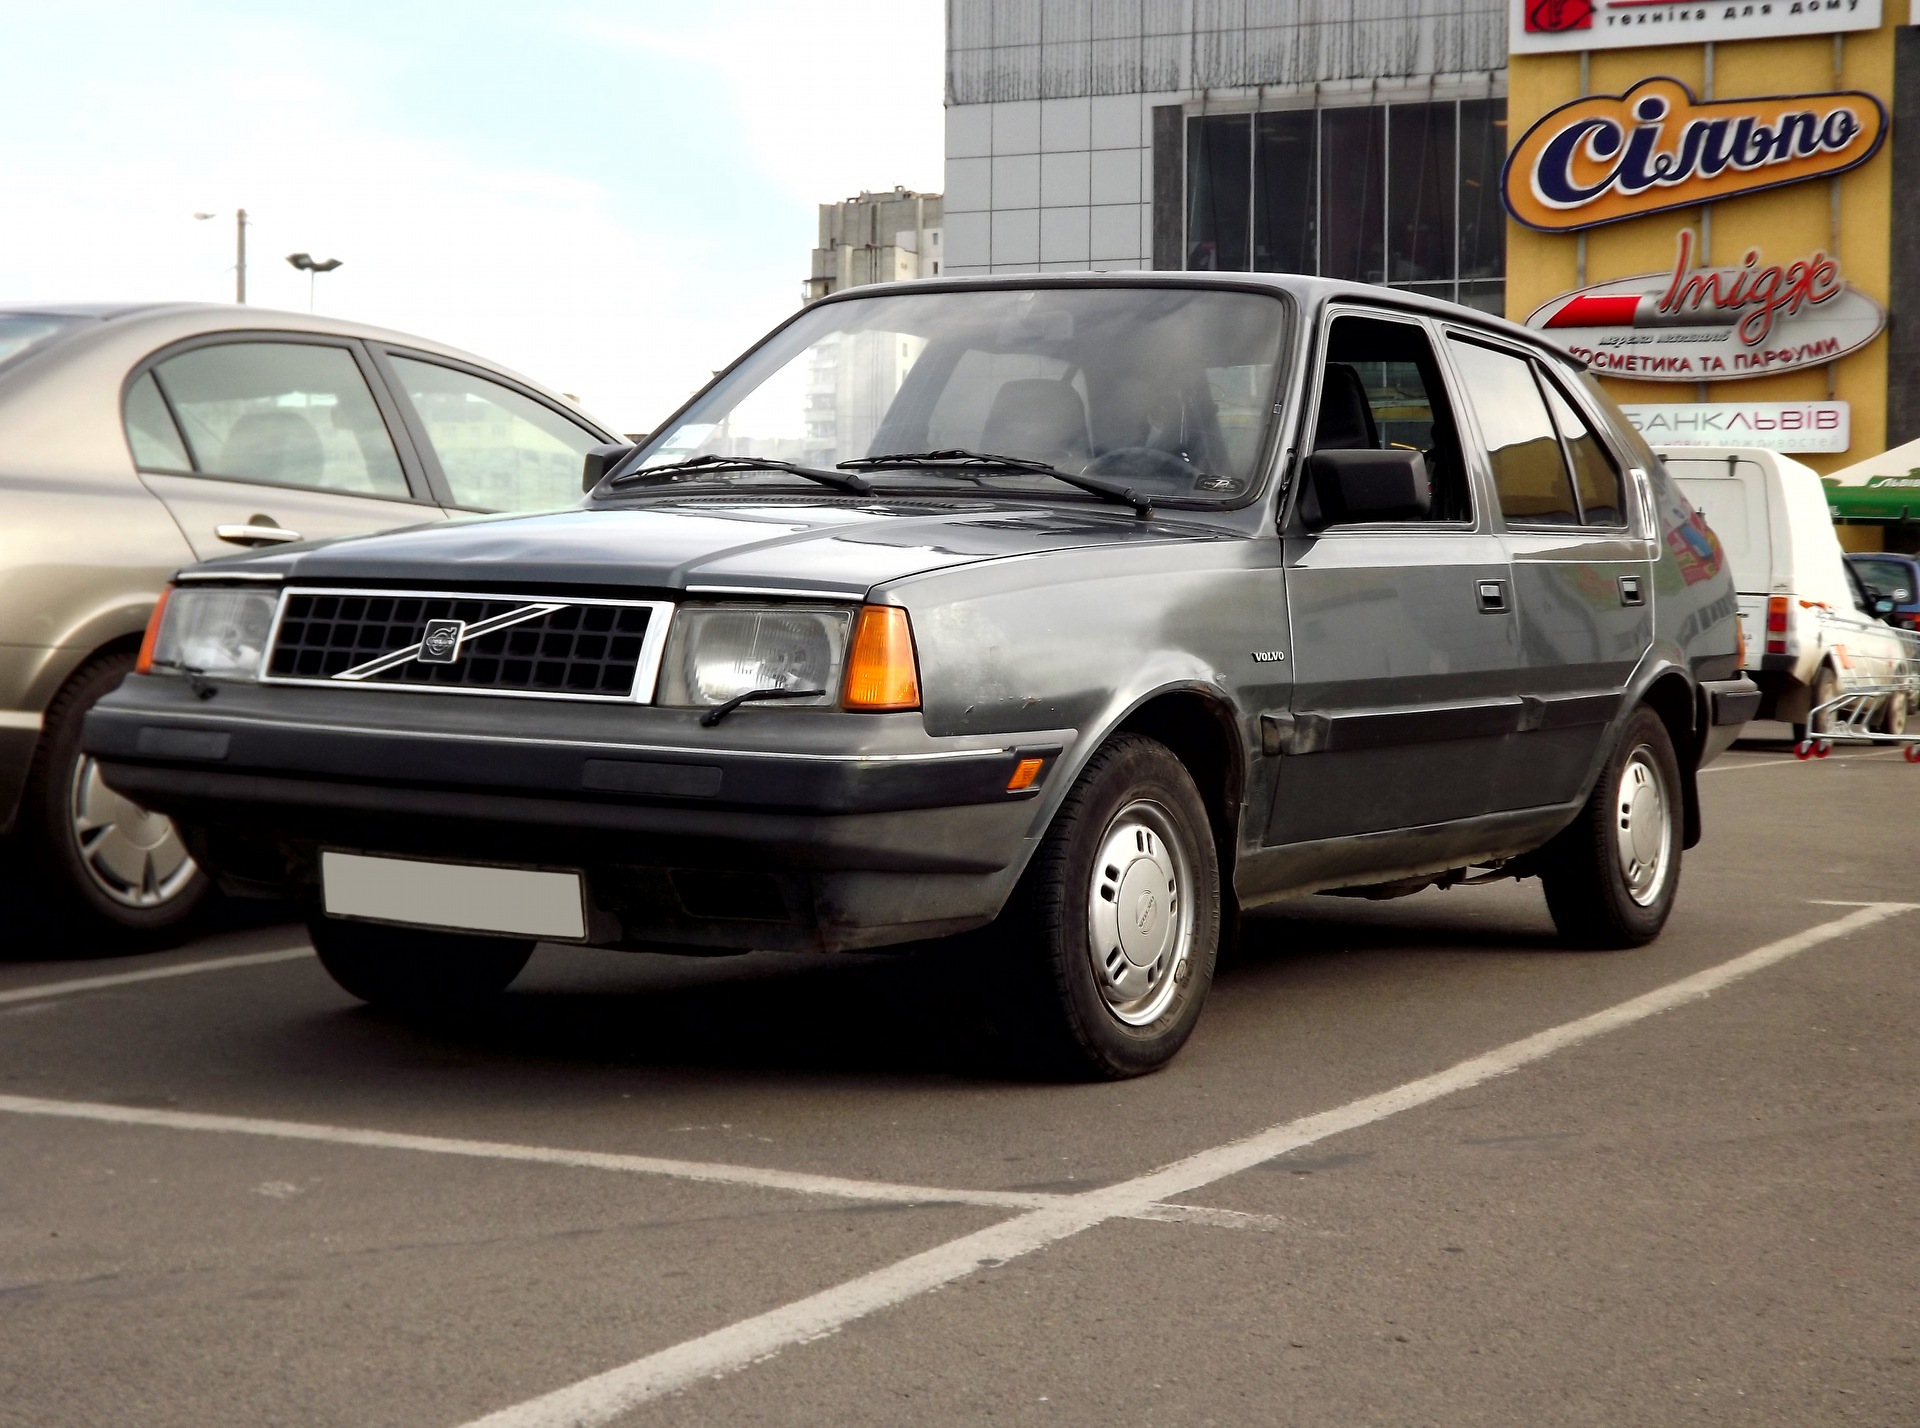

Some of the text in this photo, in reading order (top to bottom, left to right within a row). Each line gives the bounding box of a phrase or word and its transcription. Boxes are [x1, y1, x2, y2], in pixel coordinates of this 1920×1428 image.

[1605, 0, 1858, 27] техніка для дому
[1531, 95, 1861, 208] Сільпо
[1700, 356, 1725, 372] ТА
[1734, 337, 1840, 370] ПАРФУМИ
[1252, 651, 1285, 663] VOLVO
